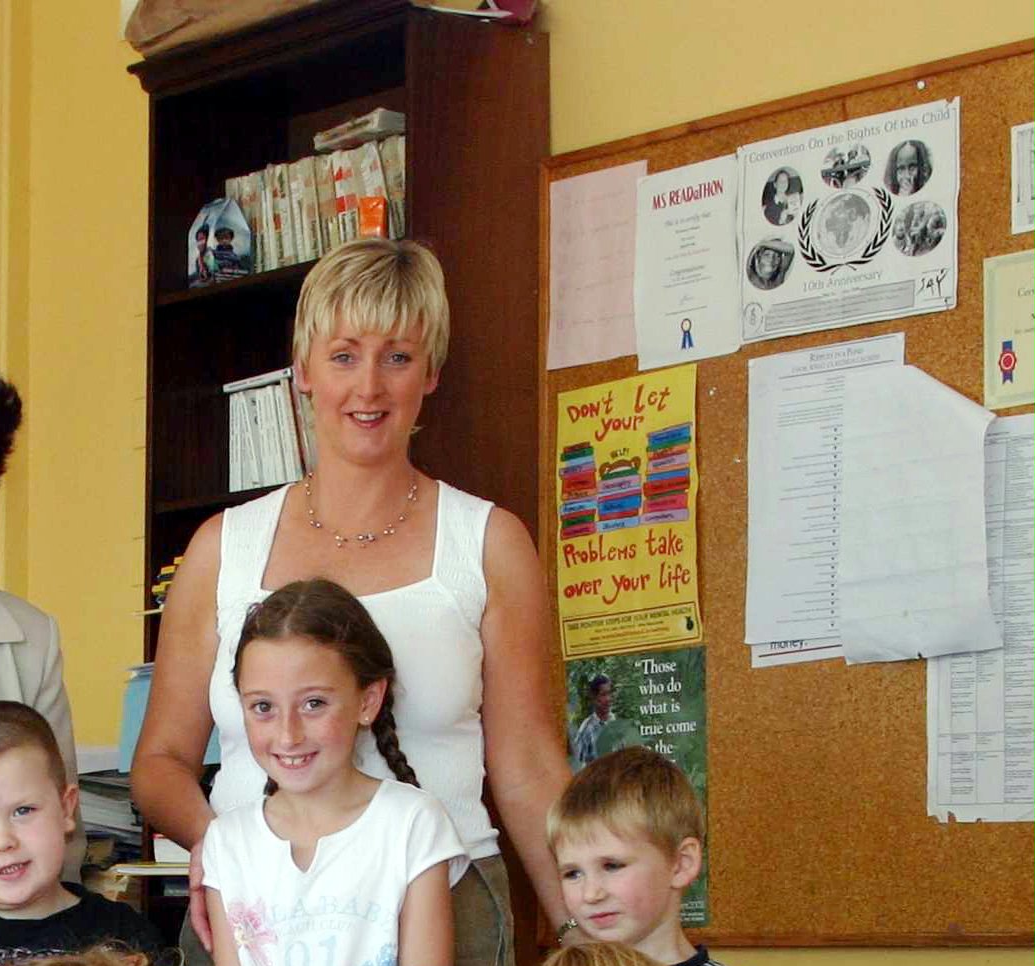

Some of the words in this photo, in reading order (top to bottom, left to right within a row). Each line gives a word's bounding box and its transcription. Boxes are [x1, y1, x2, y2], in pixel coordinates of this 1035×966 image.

[749, 143, 805, 164] Convention
[808, 138, 824, 150] On
[827, 133, 845, 147] the
[847, 124, 881, 141] Rights
[884, 118, 899, 132] Of
[900, 115, 919, 129] the
[922, 109, 950, 125] Child
[652, 193, 667, 210] MS
[803, 279, 825, 292] 10th
[828, 270, 883, 289] Anniversary
[634, 384, 671, 413] let
[595, 415, 645, 442] your
[562, 533, 637, 568] Problems
[645, 529, 684, 556] take
[563, 578, 602, 599] over
[602, 573, 651, 605] your
[659, 561, 691, 593] life
[639, 680, 664, 695] who
[667, 677, 681, 693] do
[640, 701, 667, 715] what
[671, 698, 681, 713] is
[640, 721, 664, 736] true
[666, 721, 697, 735] come
[655, 740, 674, 755] the
